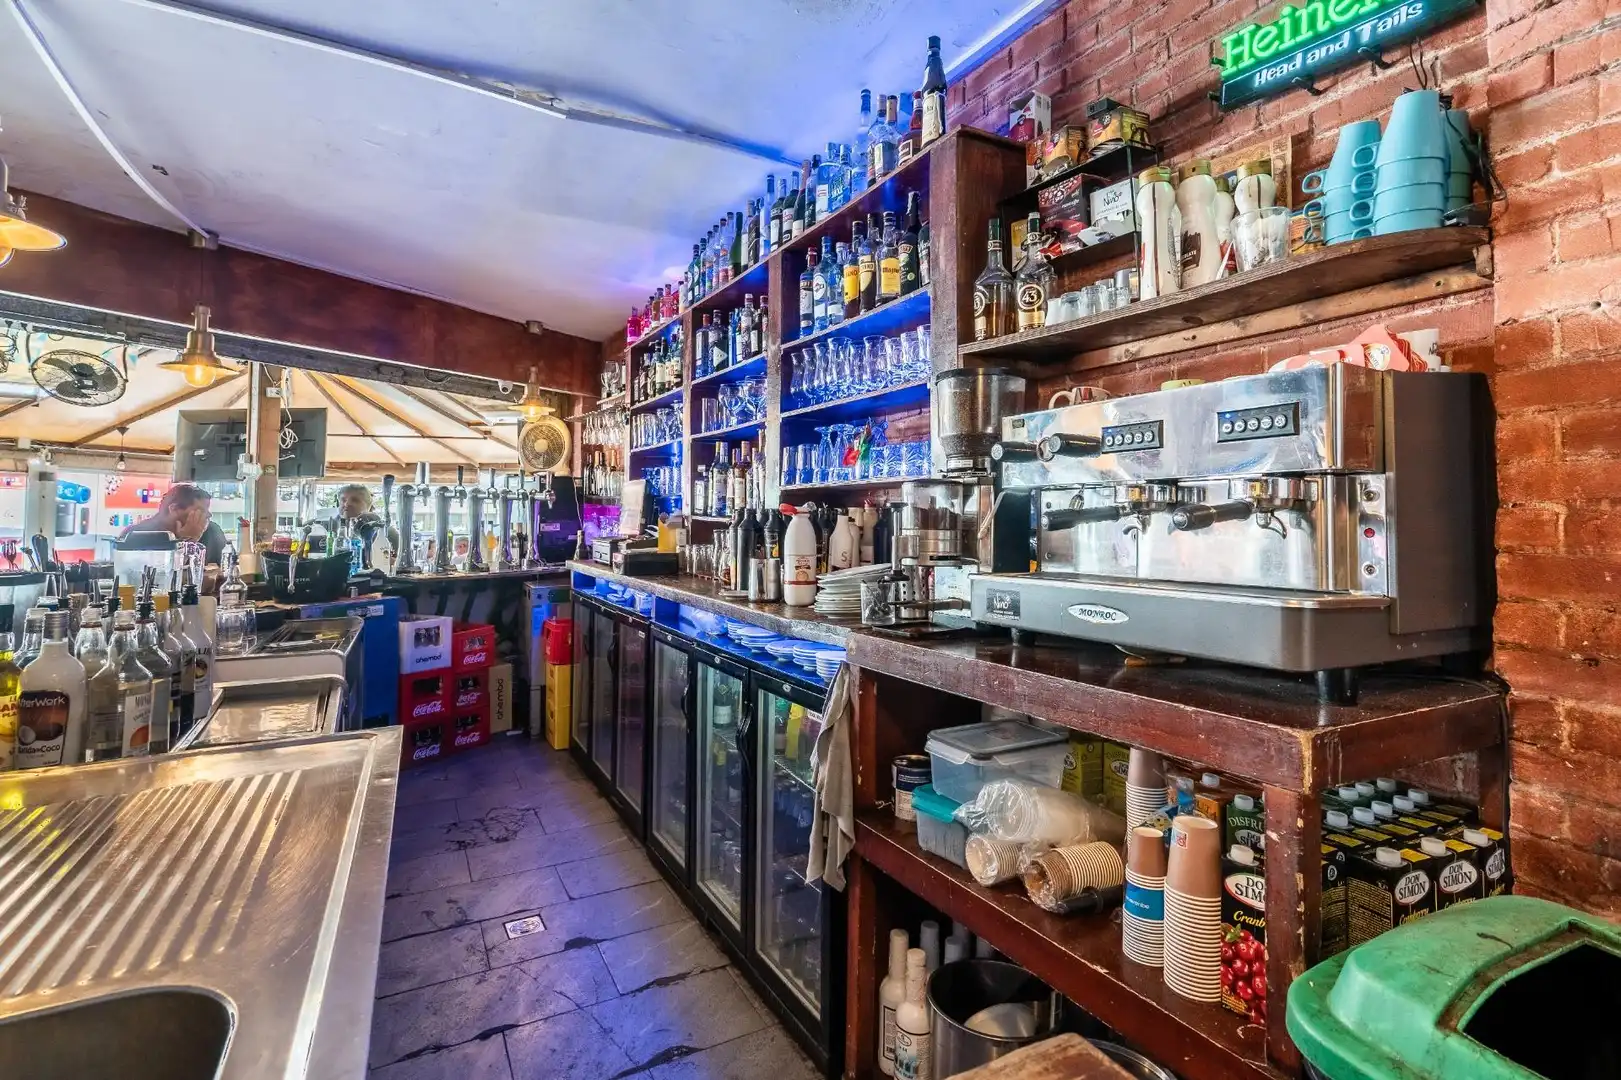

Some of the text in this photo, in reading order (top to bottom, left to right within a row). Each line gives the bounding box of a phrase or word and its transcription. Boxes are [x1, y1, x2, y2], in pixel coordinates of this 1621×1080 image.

[1221, 0, 1397, 77] Heine
[1254, 2, 1424, 87] Head and Tails
[1021, 290, 1038, 303] 43
[1078, 608, 1117, 621] MONROC
[1449, 862, 1463, 875] DON
[1246, 877, 1264, 891] DO
[1405, 873, 1421, 885] DON
[1443, 871, 1472, 888] SIMON
[1235, 884, 1265, 904] SIM
[1398, 881, 1426, 900] SIMON
[1233, 910, 1266, 928] Cranb
